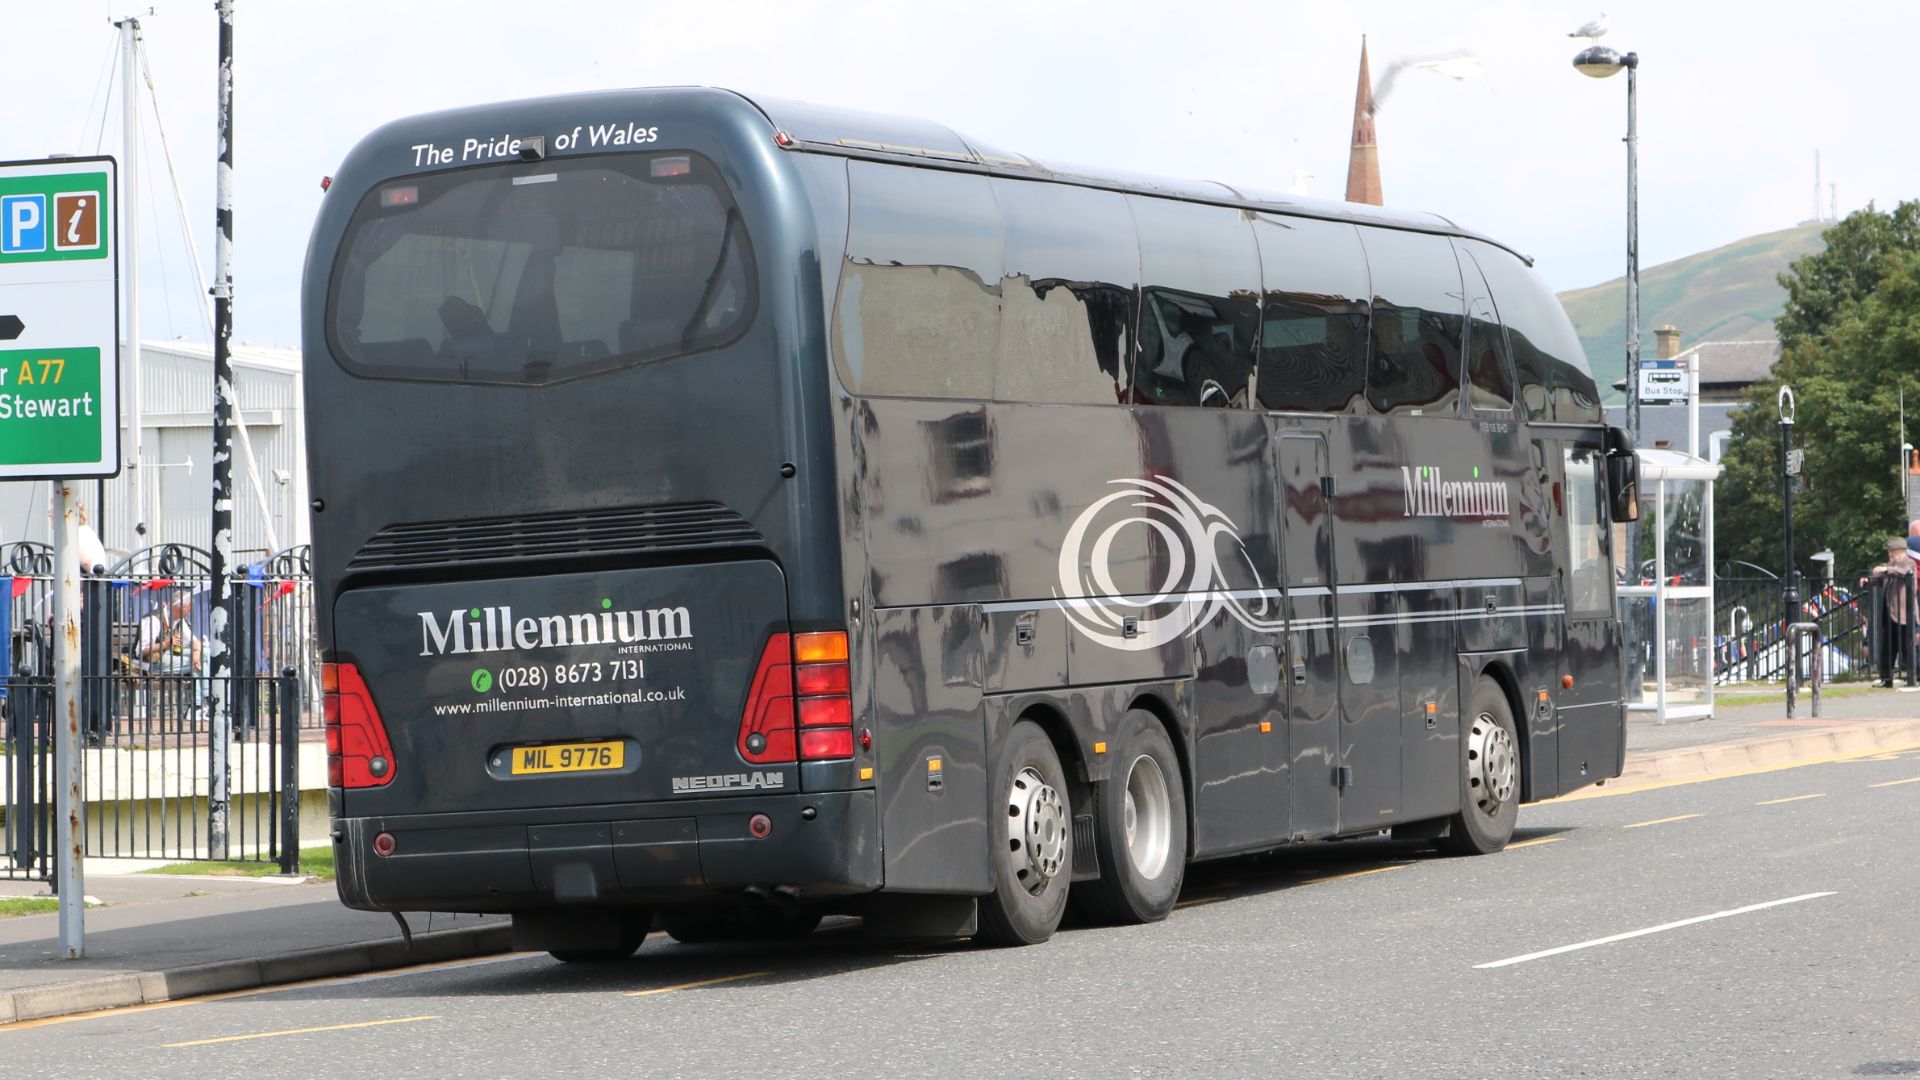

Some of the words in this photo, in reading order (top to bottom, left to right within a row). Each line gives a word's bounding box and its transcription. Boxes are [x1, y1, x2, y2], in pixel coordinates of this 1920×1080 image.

[411, 143, 454, 167] The
[462, 133, 522, 161] Pride
[555, 126, 582, 150] of
[589, 122, 658, 147] Wales
[12, 201, 40, 248] P
[17, 358, 65, 385] A77
[0, 391, 93, 419] Stewart
[1645, 386, 1660, 395] Bus
[1663, 386, 1683, 396] Stop
[1401, 465, 1510, 517] Millennium
[417, 598, 693, 657] Millennium
[618, 642, 693, 655] INTERNATIONAL
[498, 665, 548, 693] (028)
[555, 662, 602, 684] 8673
[609, 659, 644, 681] 7131
[434, 686, 686, 716] www.millennium-international.co.uk
[523, 749, 554, 770] MIL
[560, 747, 611, 768] 9776
[672, 771, 784, 793] NEOPLAN
